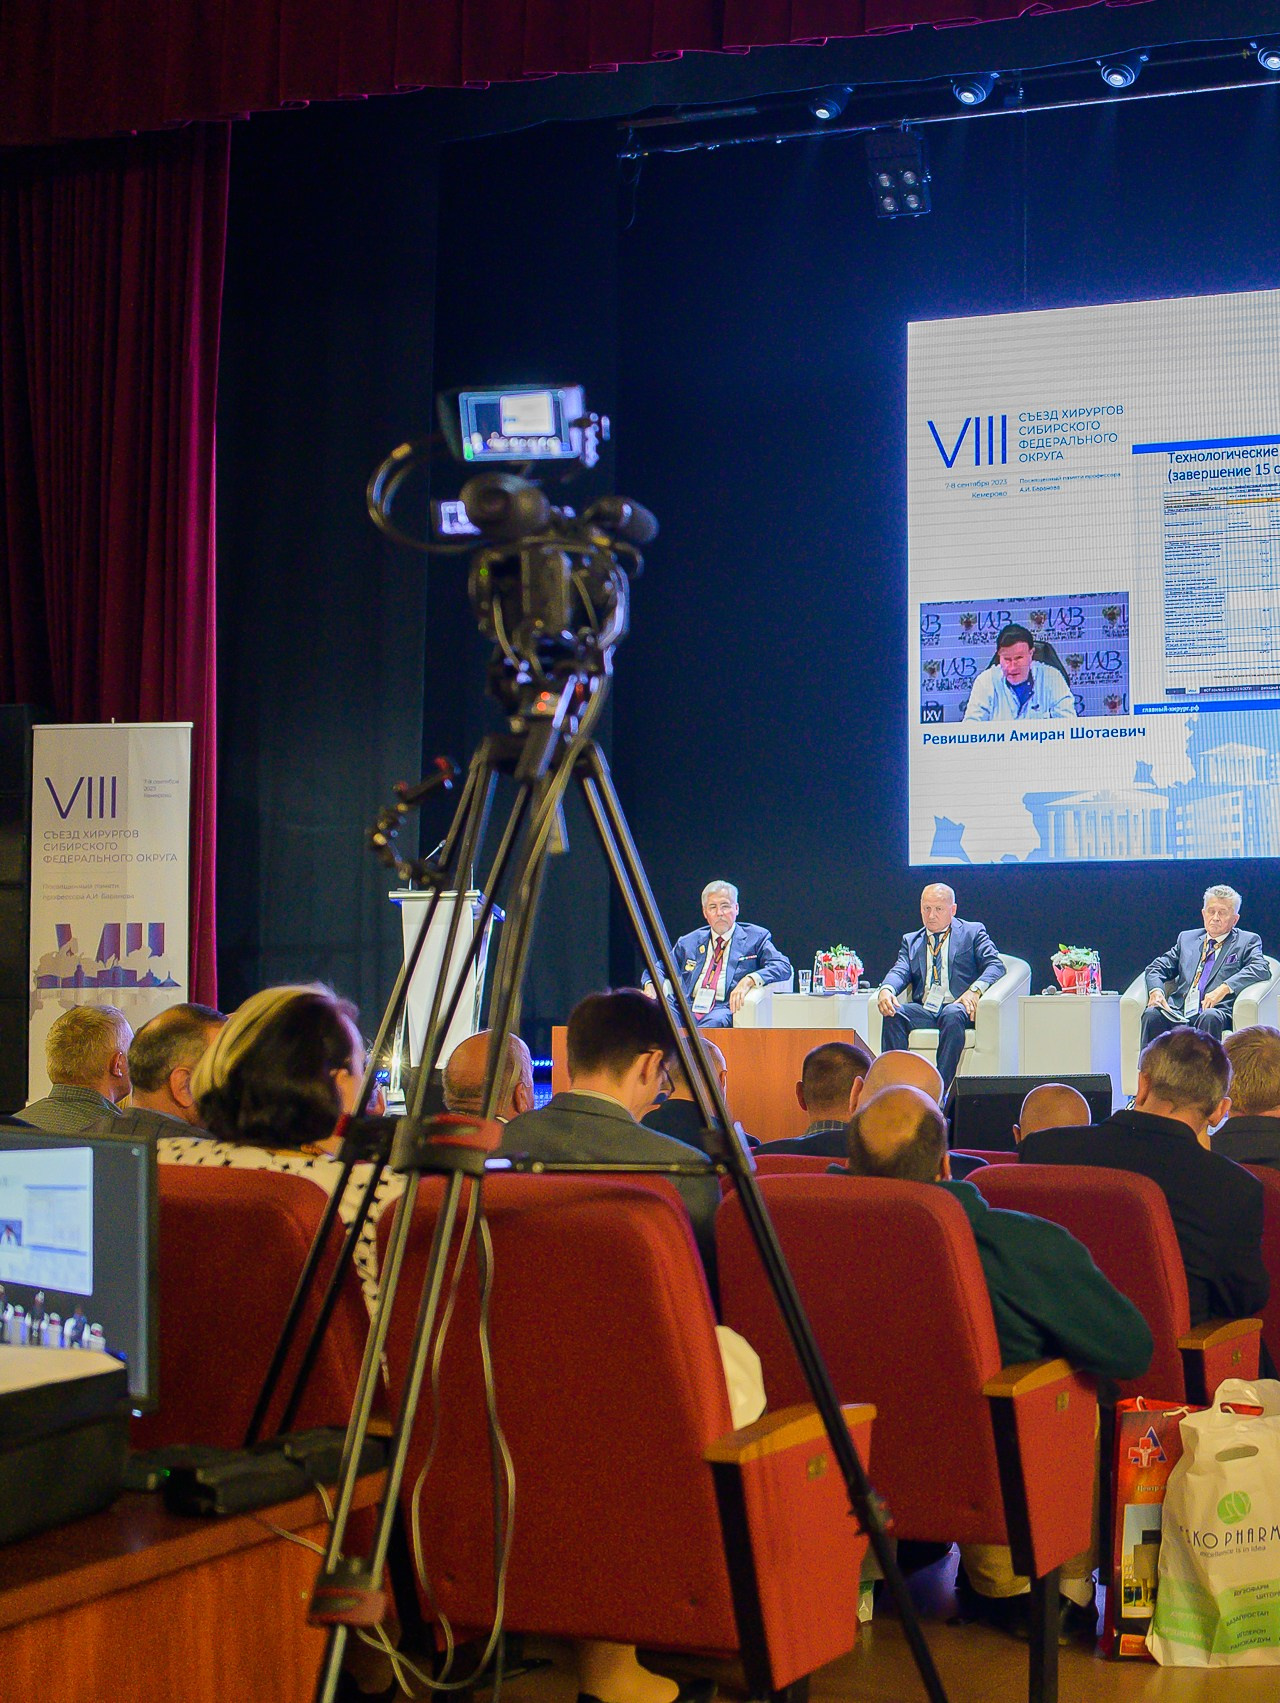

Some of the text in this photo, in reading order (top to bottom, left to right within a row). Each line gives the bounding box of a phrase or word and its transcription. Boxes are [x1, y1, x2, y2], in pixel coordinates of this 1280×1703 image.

[1019, 404, 1124, 423] СЪЕЗД ХИРУРГОВ
[1019, 420, 1101, 436] СИБИРСКОГО
[927, 414, 1008, 468] VIII
[1018, 432, 1118, 449] ФЕДЕРАЛЬНОГО
[1018, 450, 1064, 463] ОКРУГА
[1167, 445, 1279, 464] Технологические
[1167, 466, 1251, 484] (завершение
[1255, 463, 1271, 477] 15
[923, 726, 1146, 745] Ревишвили Амиран Шотаевич
[44, 776, 117, 819] VIII
[43, 829, 139, 840] СЪЕЗД ХИРУРГОВ
[43, 842, 118, 852] СИБИРСКОГО
[43, 853, 178, 864] ФЕДЕРАЛЬНОГО ОКРУГА
